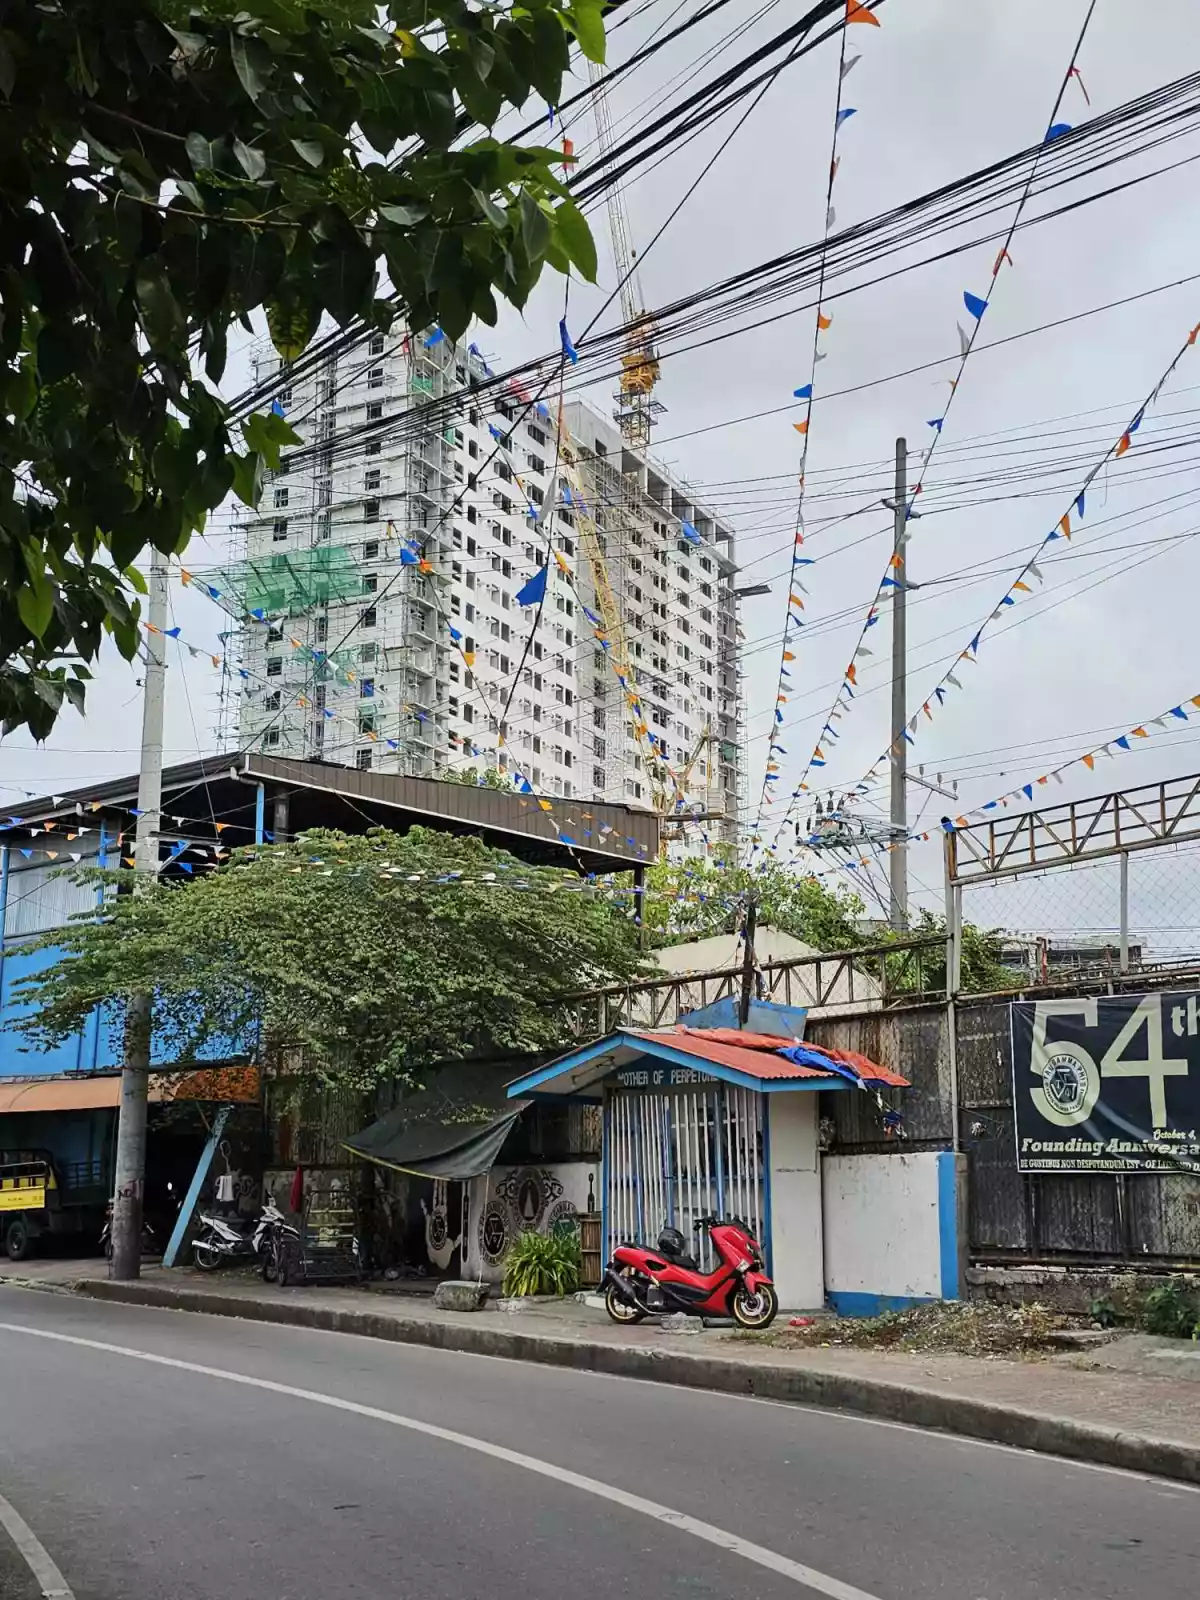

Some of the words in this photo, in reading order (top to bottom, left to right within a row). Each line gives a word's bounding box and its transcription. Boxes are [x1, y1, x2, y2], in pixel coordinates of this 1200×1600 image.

[653, 1070, 665, 1085] OF
[1153, 1128, 1186, 1140] October
[1021, 1138, 1105, 1156] Founding
[1061, 1159, 1076, 1168] NON
[1126, 1159, 1140, 1169] EST
